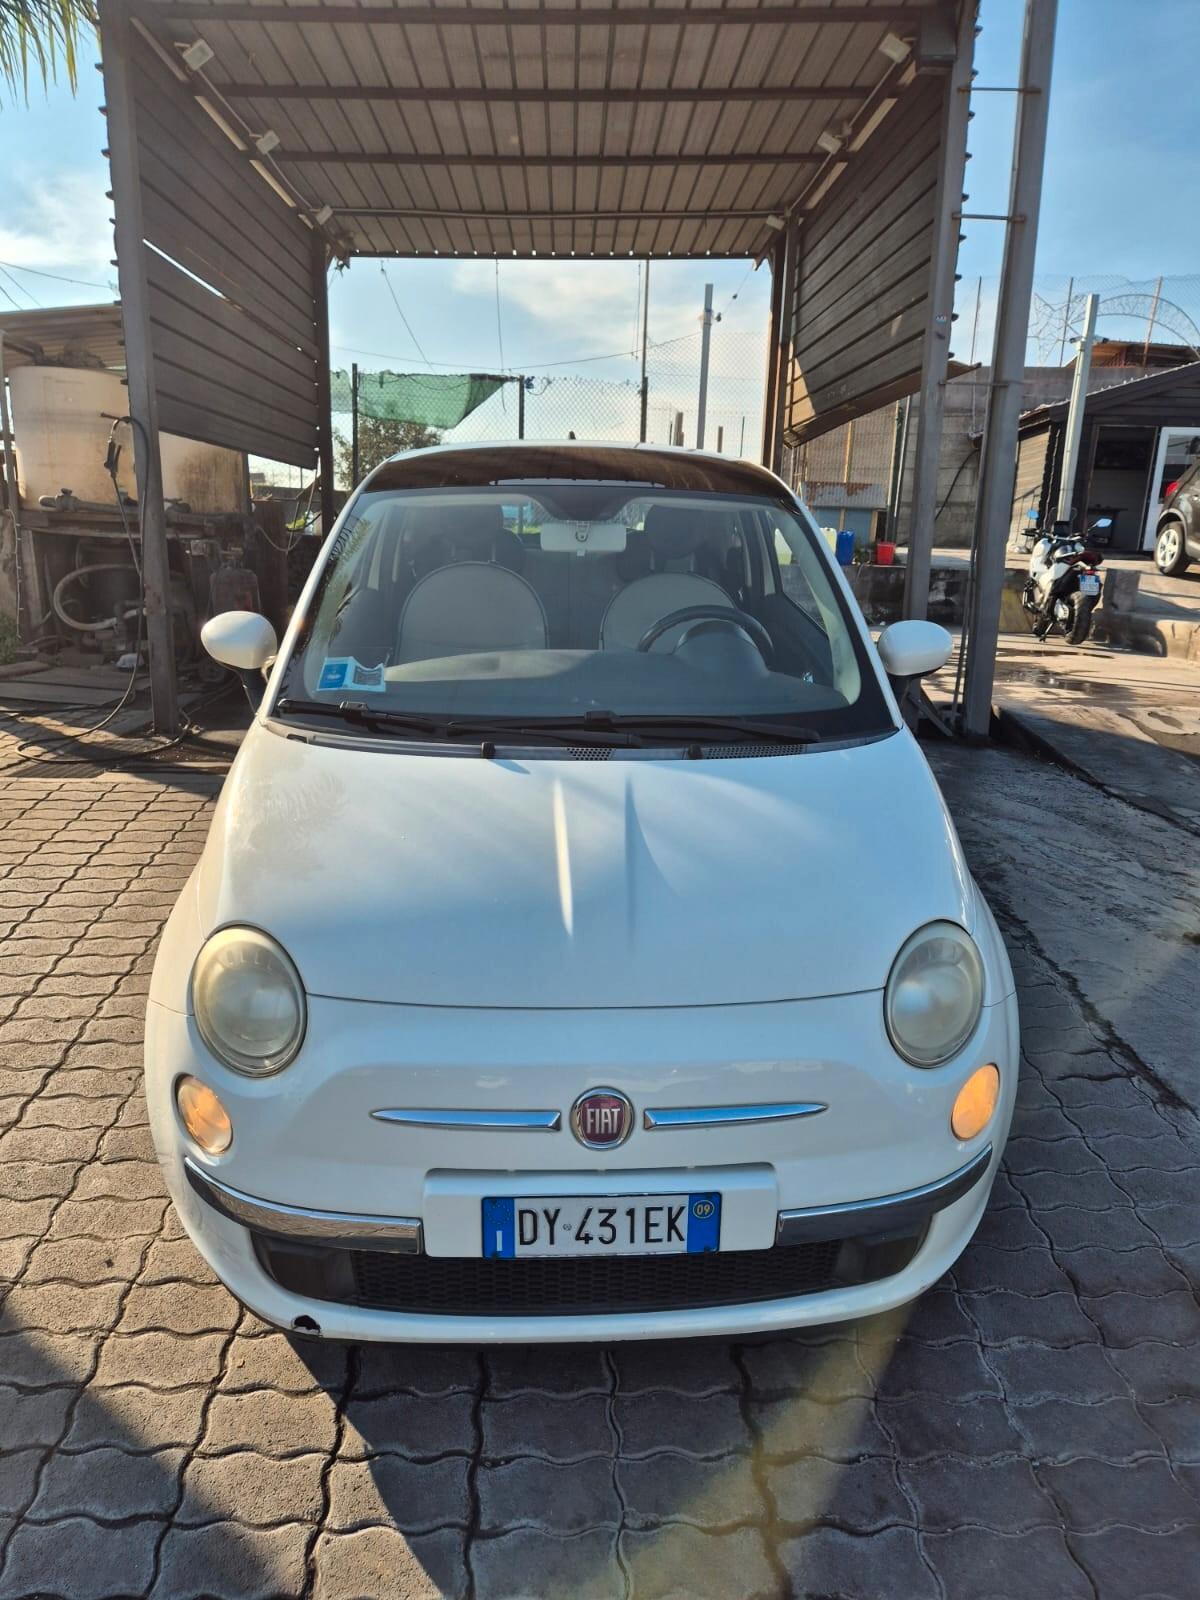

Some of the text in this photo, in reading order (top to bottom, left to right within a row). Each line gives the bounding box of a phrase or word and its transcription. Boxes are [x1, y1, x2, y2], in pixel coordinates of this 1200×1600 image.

[586, 1108, 621, 1134] FIAT
[696, 1204, 711, 1216] 09
[518, 1206, 686, 1246] DY 431EK
[496, 1230, 503, 1252] I
